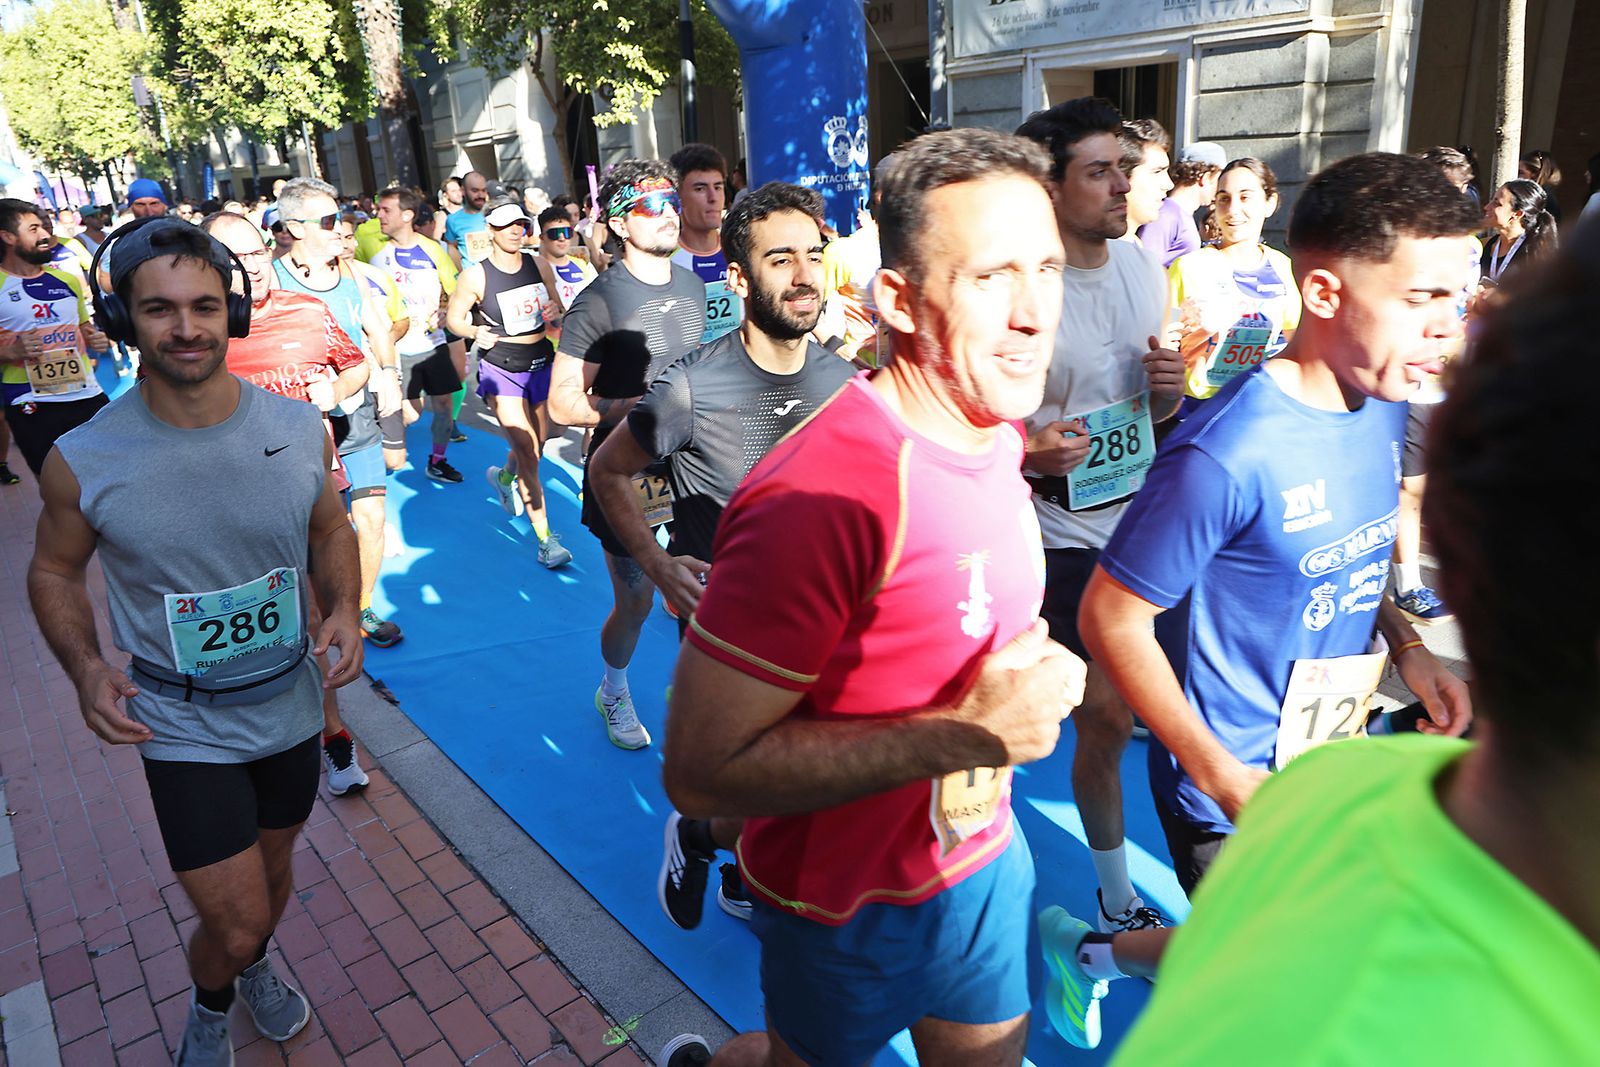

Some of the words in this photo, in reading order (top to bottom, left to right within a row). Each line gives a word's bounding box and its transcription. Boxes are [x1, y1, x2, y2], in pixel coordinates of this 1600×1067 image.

[32, 303, 60, 319] 21K
[1223, 344, 1266, 366] 505
[33, 359, 81, 380] 1379
[1087, 423, 1141, 469] 288
[1074, 467, 1125, 489] RODRIGUEZ
[1075, 481, 1116, 499] Huelva
[267, 570, 288, 591] 21K
[176, 596, 205, 614] 21K
[198, 600, 280, 652] 286
[196, 653, 225, 669] RUIZ
